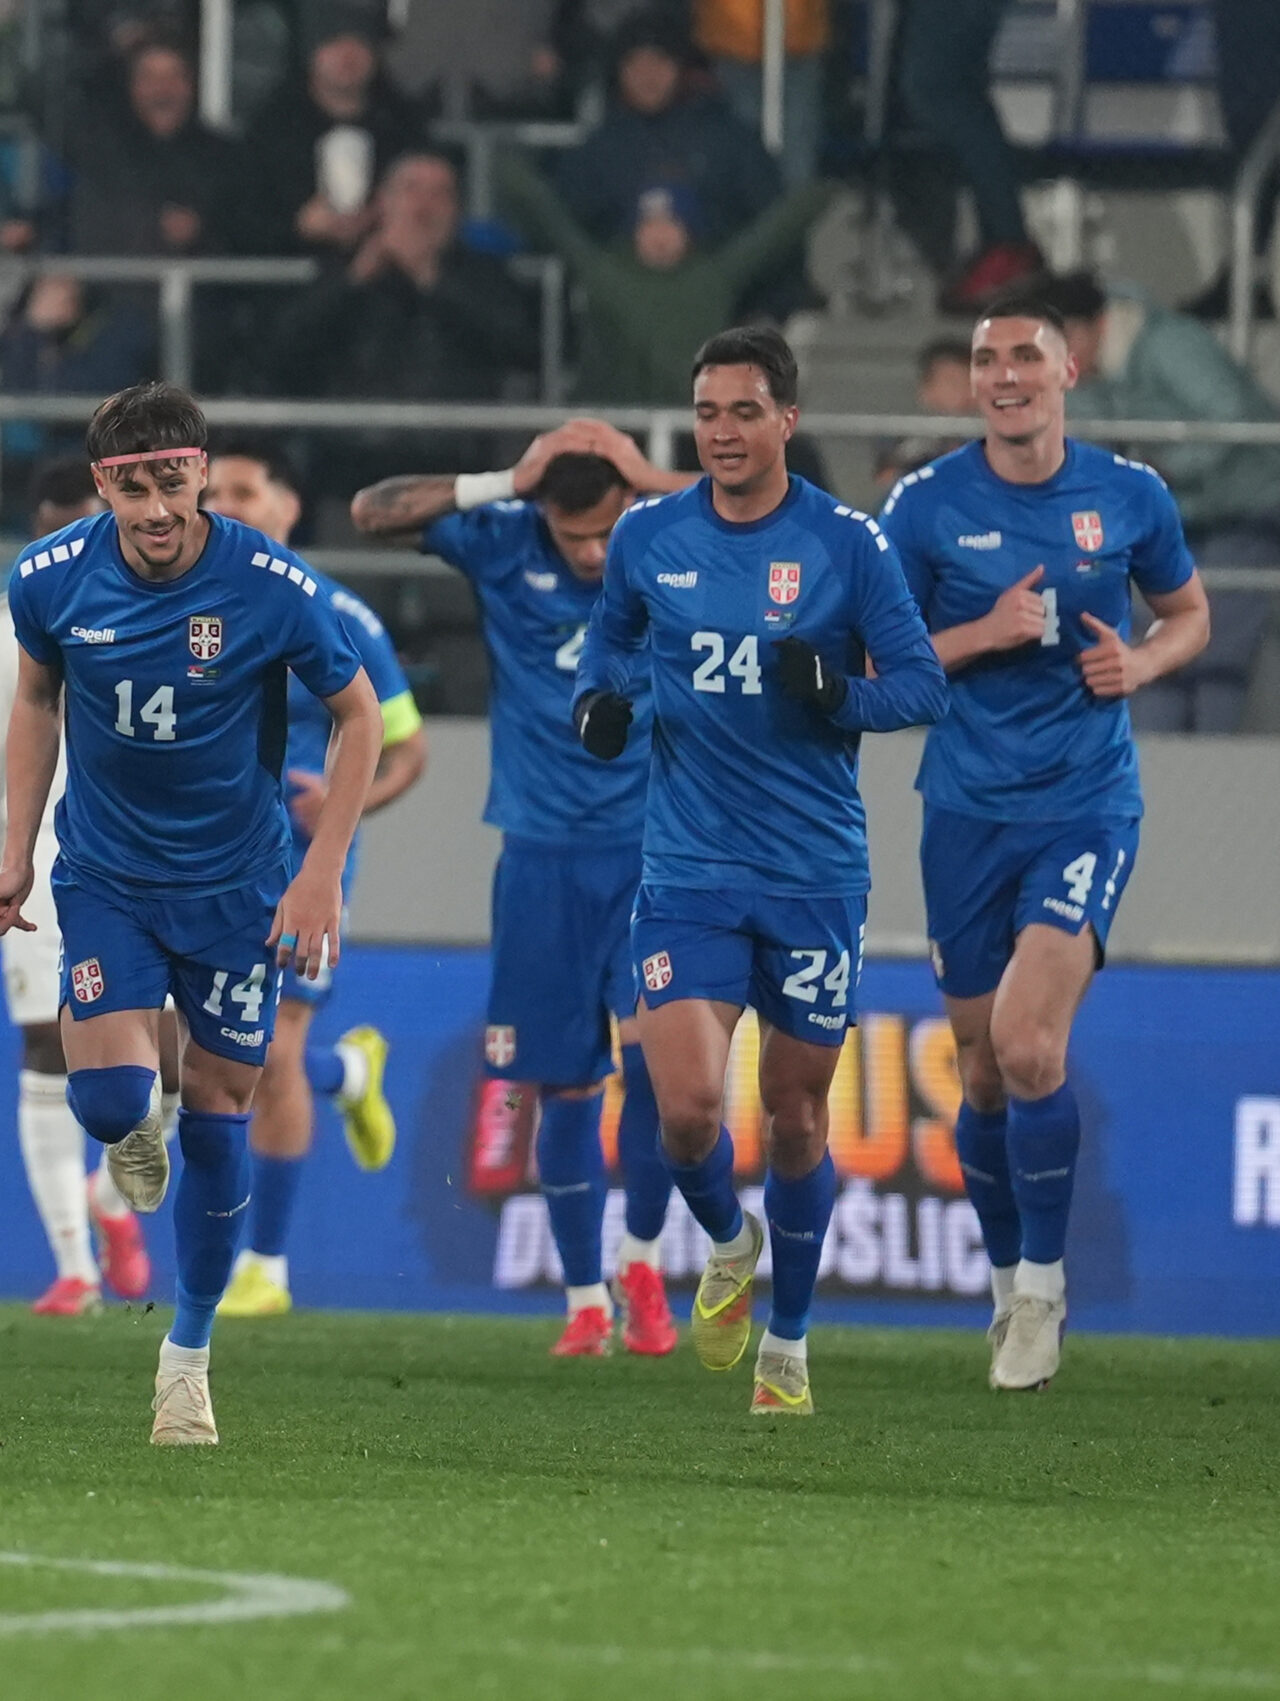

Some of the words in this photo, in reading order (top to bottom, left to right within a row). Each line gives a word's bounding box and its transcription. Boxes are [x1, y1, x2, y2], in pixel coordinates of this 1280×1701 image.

[657, 571, 698, 588] capelli
[70, 626, 116, 644] capelli
[690, 631, 762, 695] 24
[114, 679, 177, 741] 14
[1062, 851, 1097, 906] 4
[202, 963, 266, 1022] 14
[781, 949, 850, 1007] 24
[220, 1027, 264, 1047] capelli
